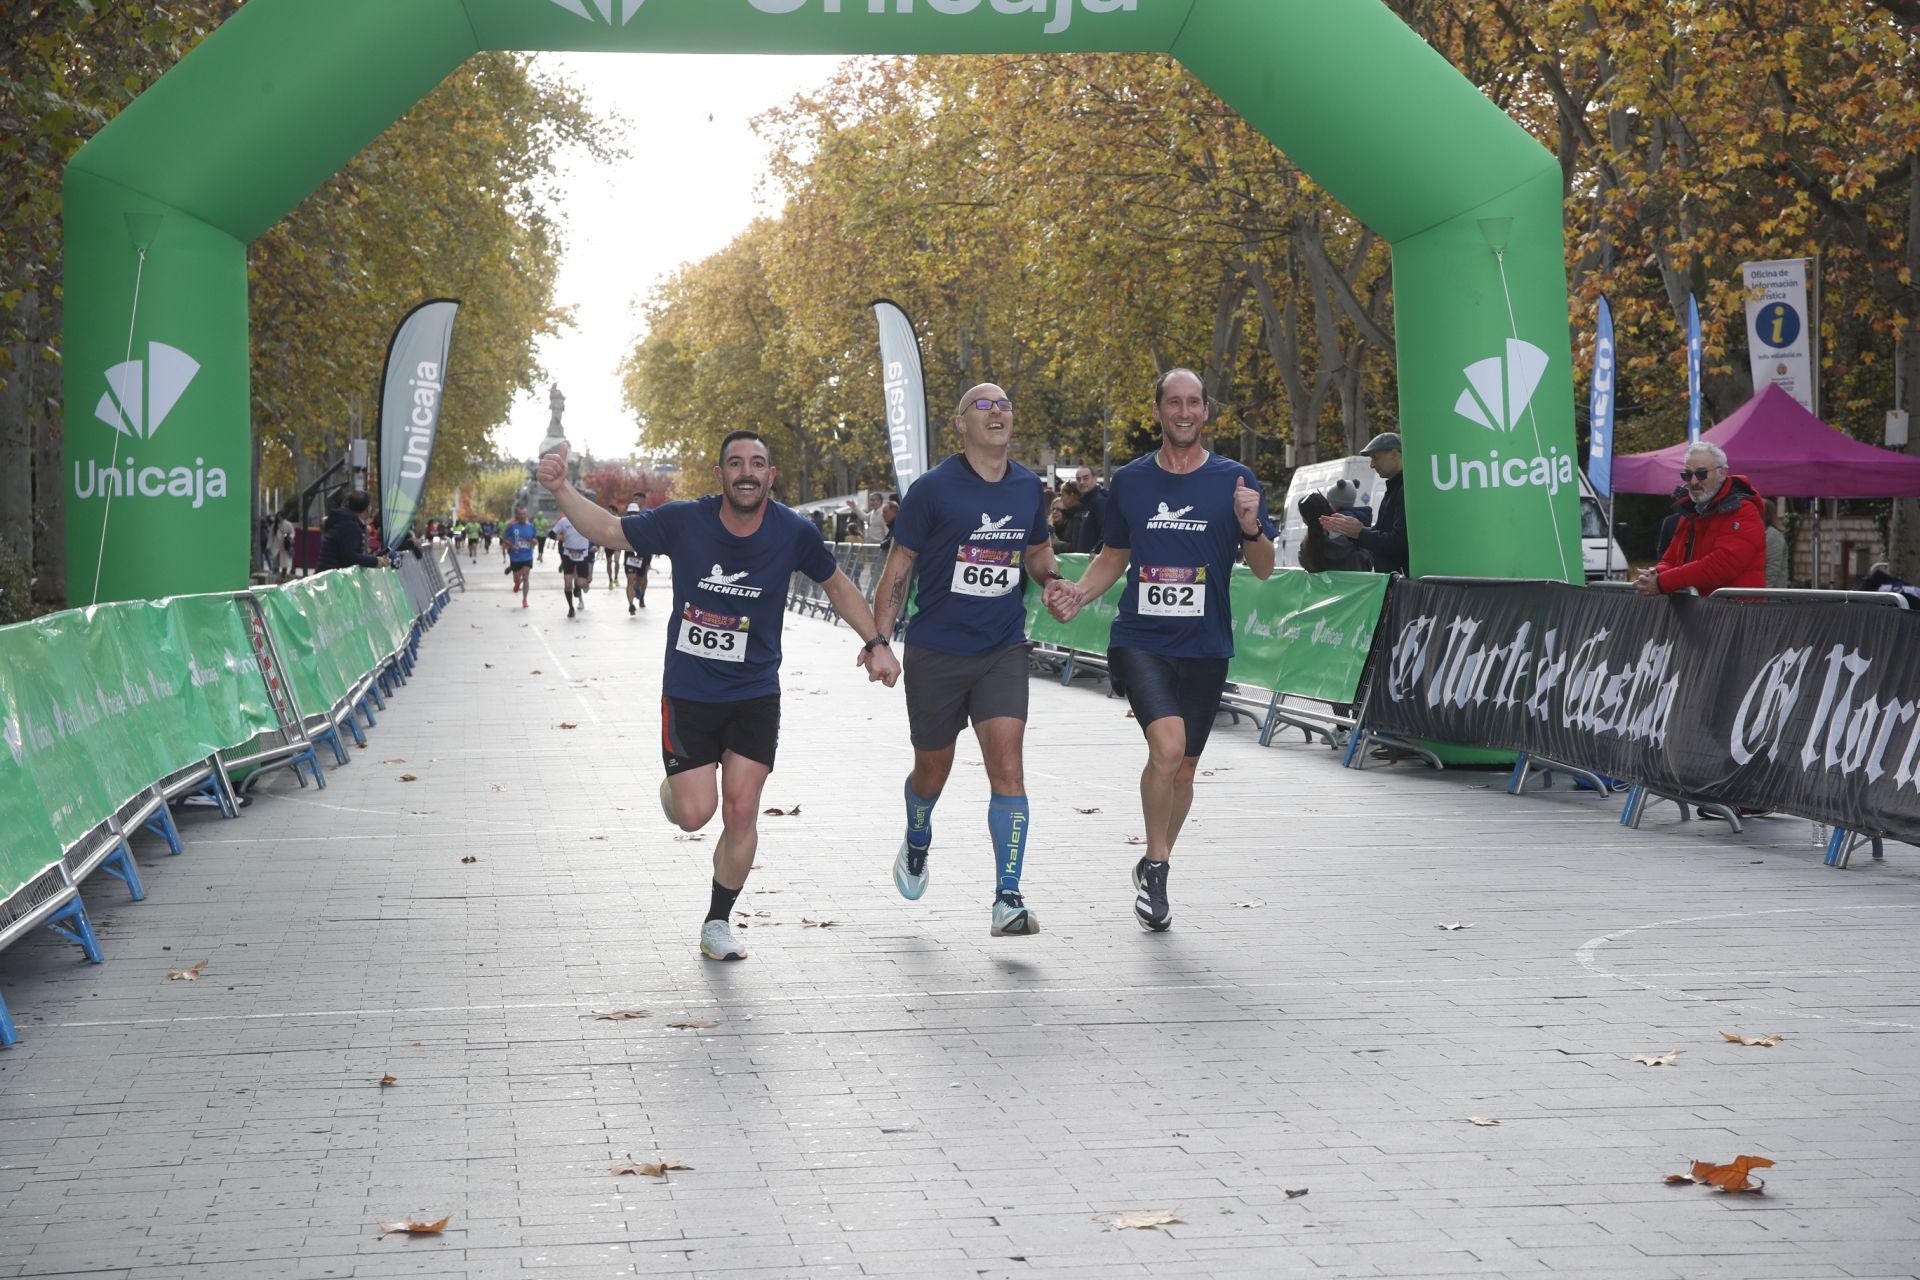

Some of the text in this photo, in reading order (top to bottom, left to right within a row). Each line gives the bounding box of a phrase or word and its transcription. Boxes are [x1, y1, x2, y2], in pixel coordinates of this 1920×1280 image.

[1751, 268, 1789, 279] Oficina de
[1752, 279, 1798, 289] Información
[401, 361, 441, 479] Unicaja
[1431, 446, 1572, 496] Unicaja
[74, 457, 227, 508] Unicaja
[969, 532, 1024, 540] MICHELIN
[1146, 521, 1207, 531] MICHELIN
[963, 566, 1009, 588] 664
[697, 581, 761, 598] MICHELIN
[1148, 586, 1194, 606] 662
[688, 626, 735, 651] 663
[1428, 615, 1533, 711] Norte
